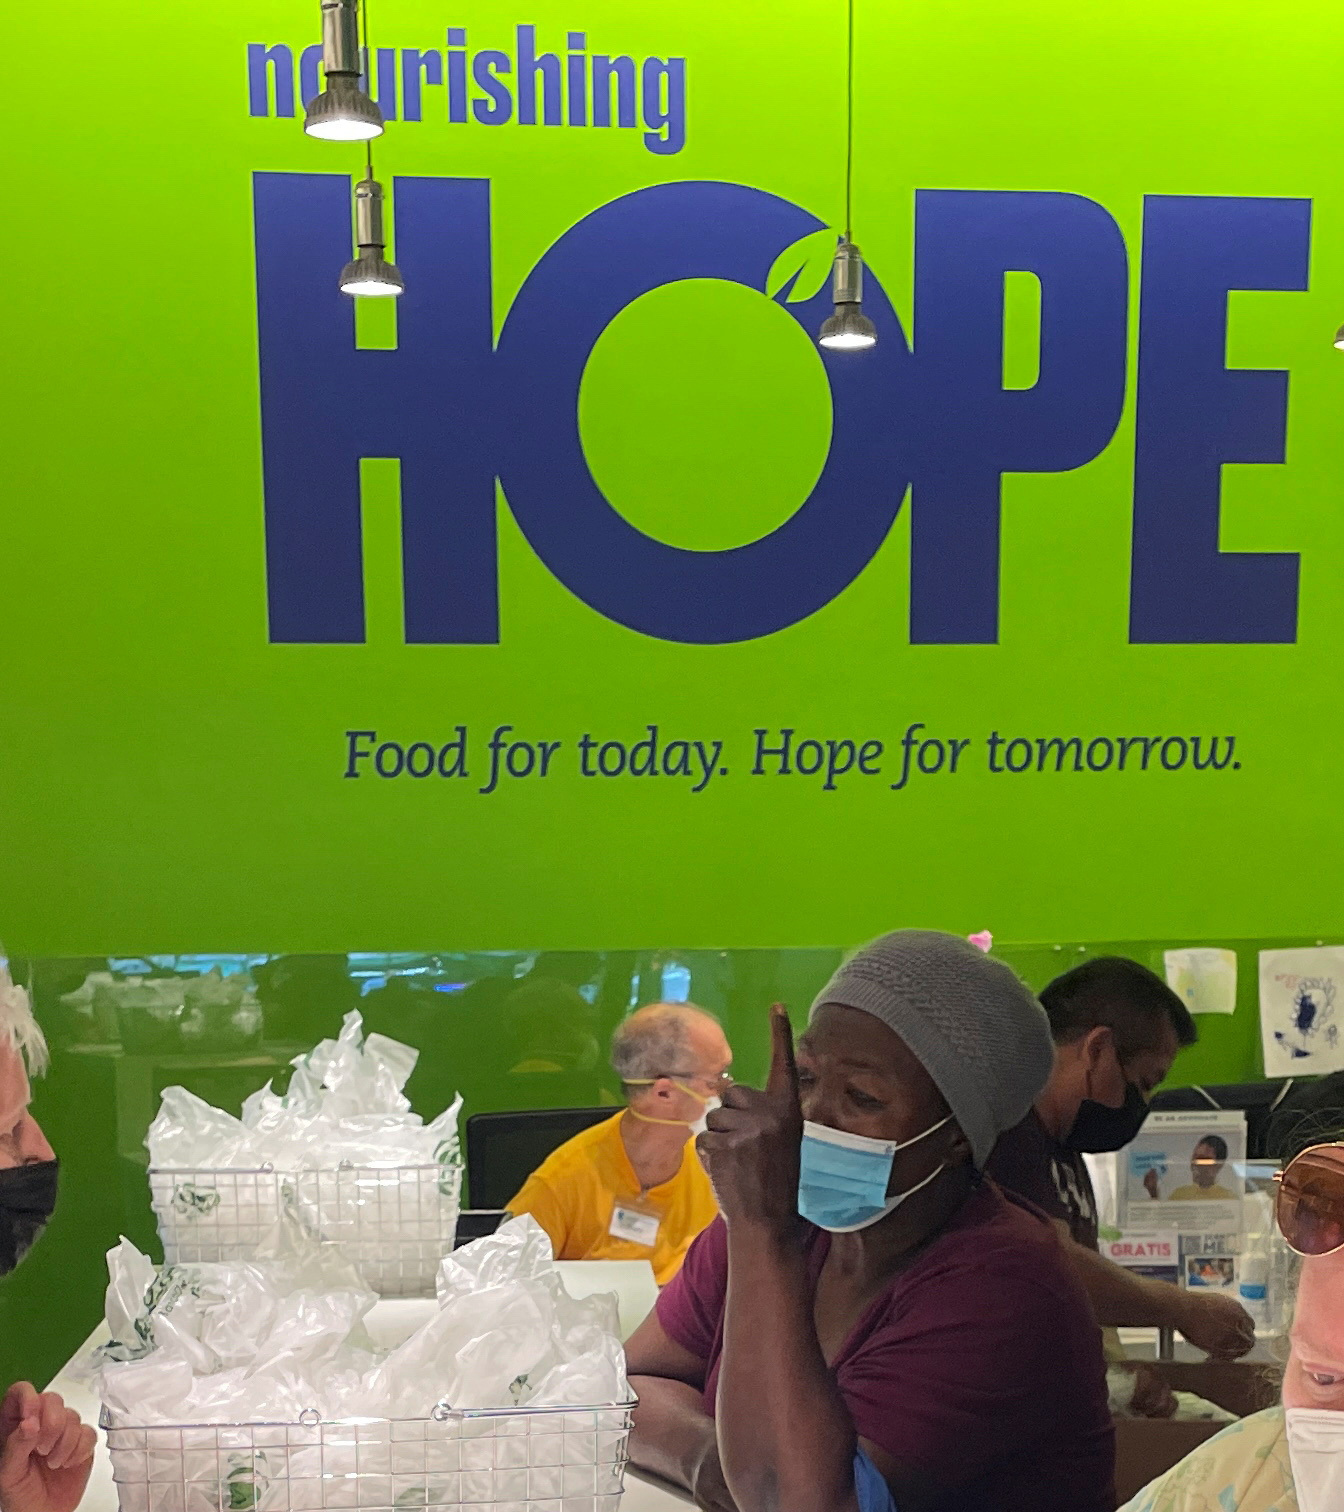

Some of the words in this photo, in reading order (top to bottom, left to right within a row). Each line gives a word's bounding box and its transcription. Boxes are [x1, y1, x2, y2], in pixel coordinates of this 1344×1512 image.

[253, 171, 1312, 645] HOPE
[343, 725, 470, 780] Food
[479, 725, 561, 795] for
[578, 725, 730, 793] today.
[751, 728, 884, 791] Hope
[892, 722, 971, 790] for
[986, 727, 1242, 775] tomorrow.
[1110, 1241, 1171, 1257] GRATIS
